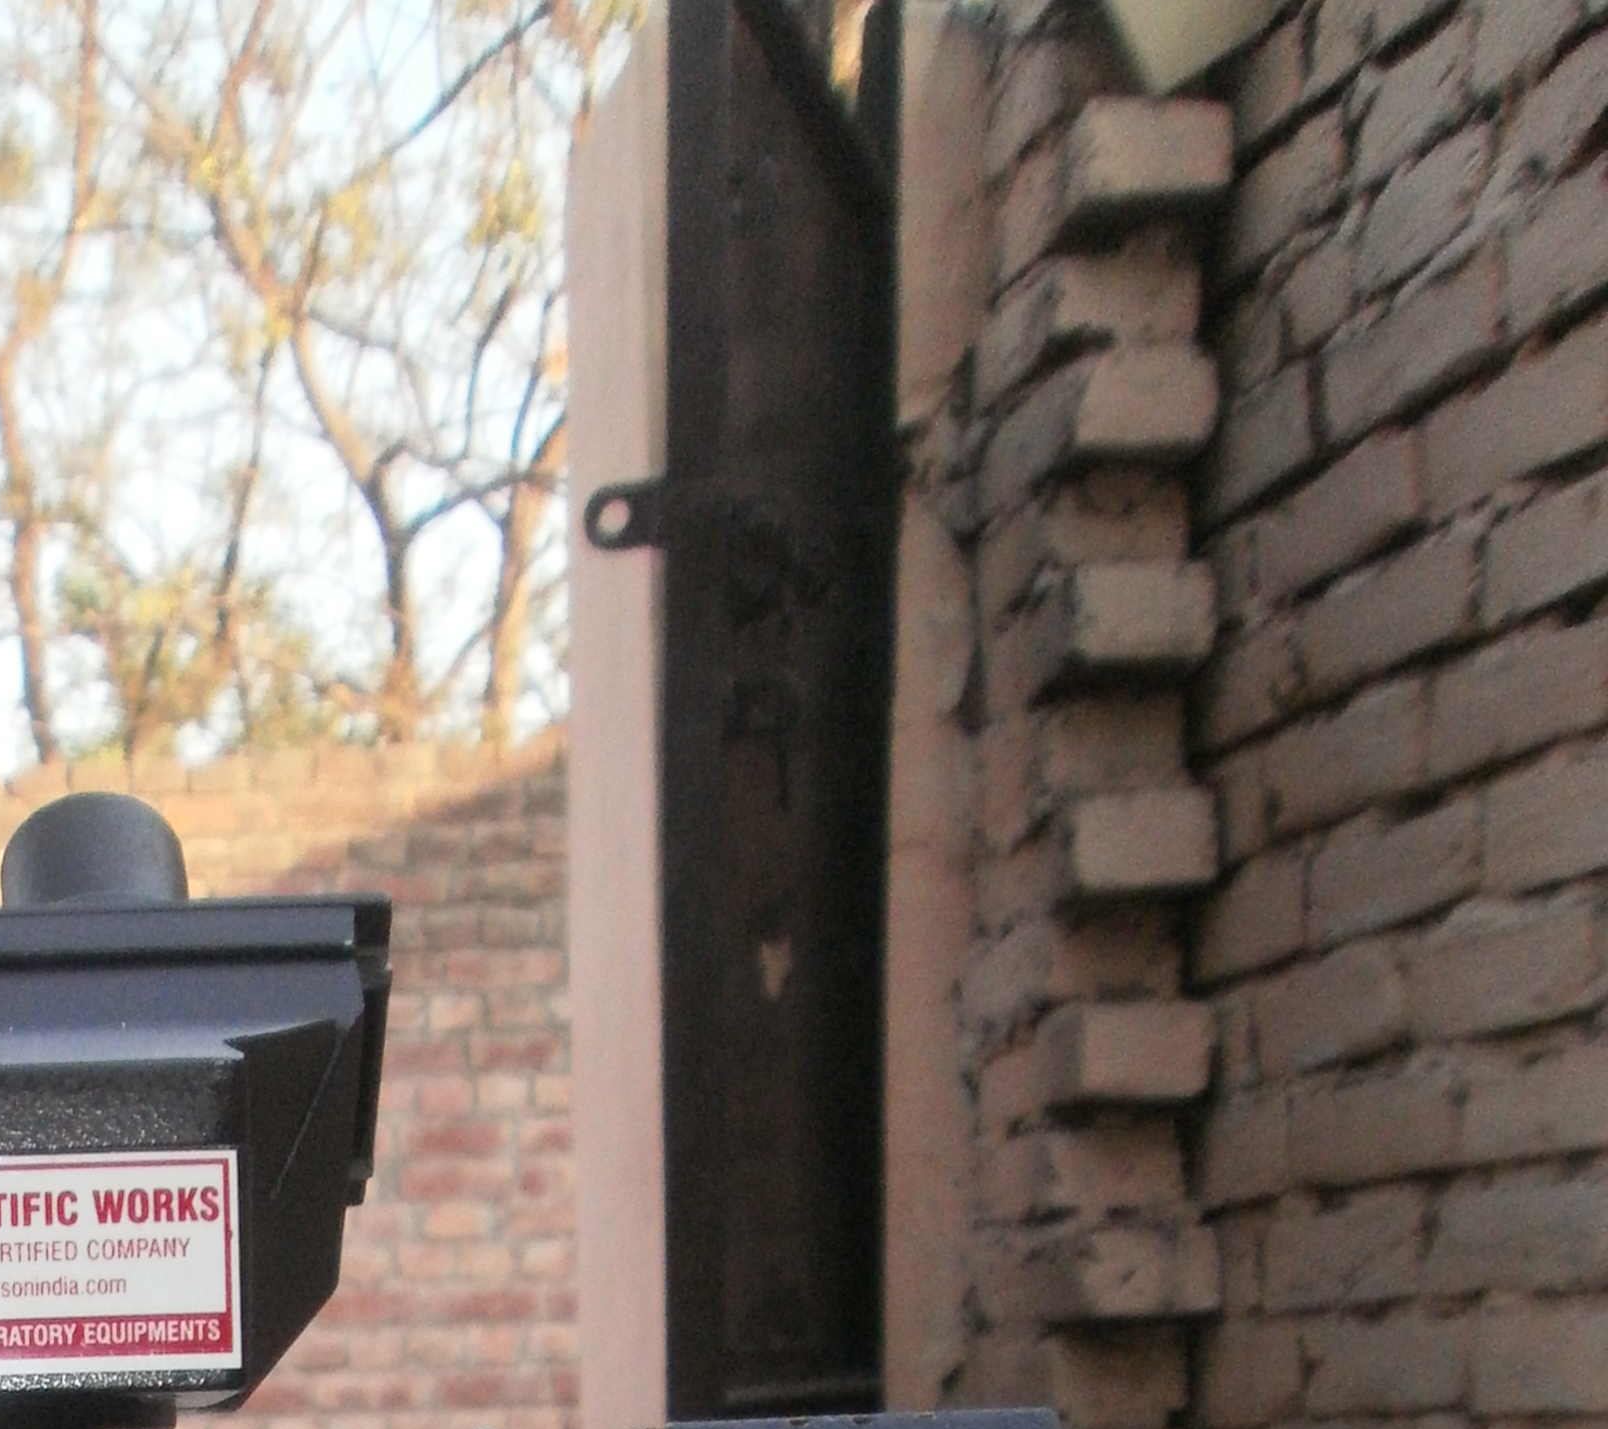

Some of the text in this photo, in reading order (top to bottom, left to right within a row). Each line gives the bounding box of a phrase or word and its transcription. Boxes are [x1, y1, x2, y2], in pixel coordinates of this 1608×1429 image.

[92, 1186, 221, 1224] WORKS
[87, 1237, 192, 1261] COMPANY
[83, 1318, 222, 1344] EQUIPMENTS
